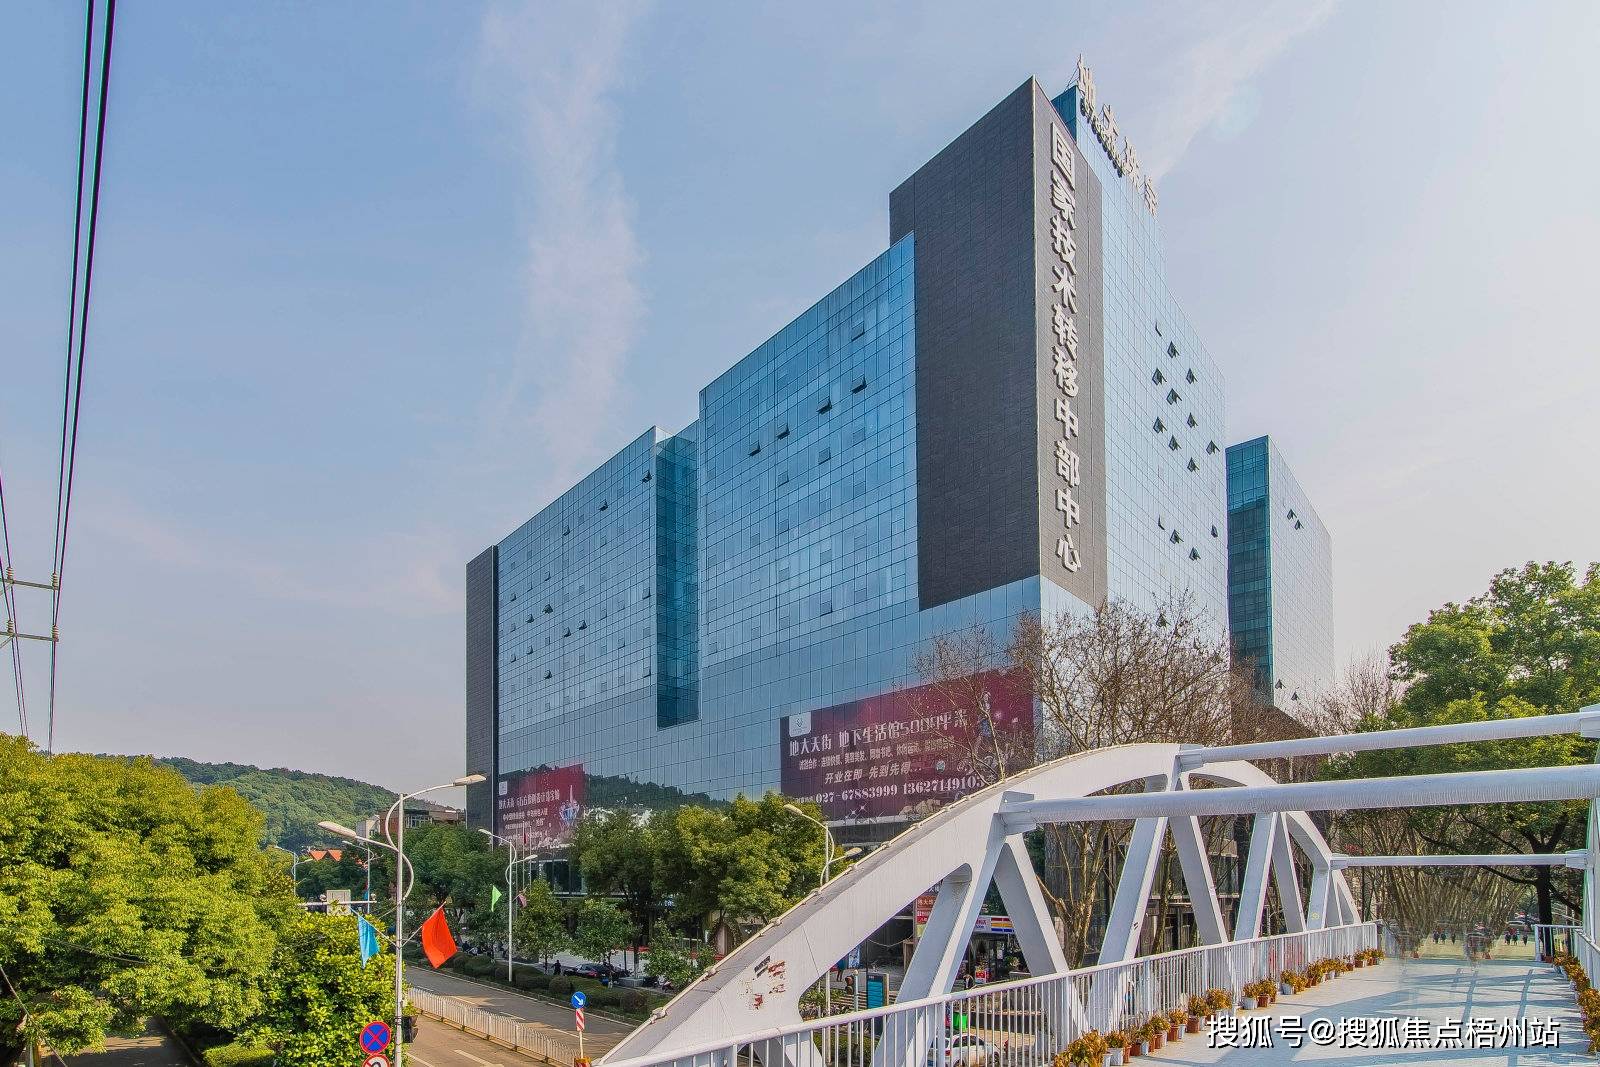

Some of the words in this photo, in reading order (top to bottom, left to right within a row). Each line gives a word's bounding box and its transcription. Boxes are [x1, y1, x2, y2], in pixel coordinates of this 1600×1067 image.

[1051, 122, 1081, 573] 国家技术转移中部中心
[790, 733, 832, 757] 地大天街
[825, 768, 863, 785] 开业在即
